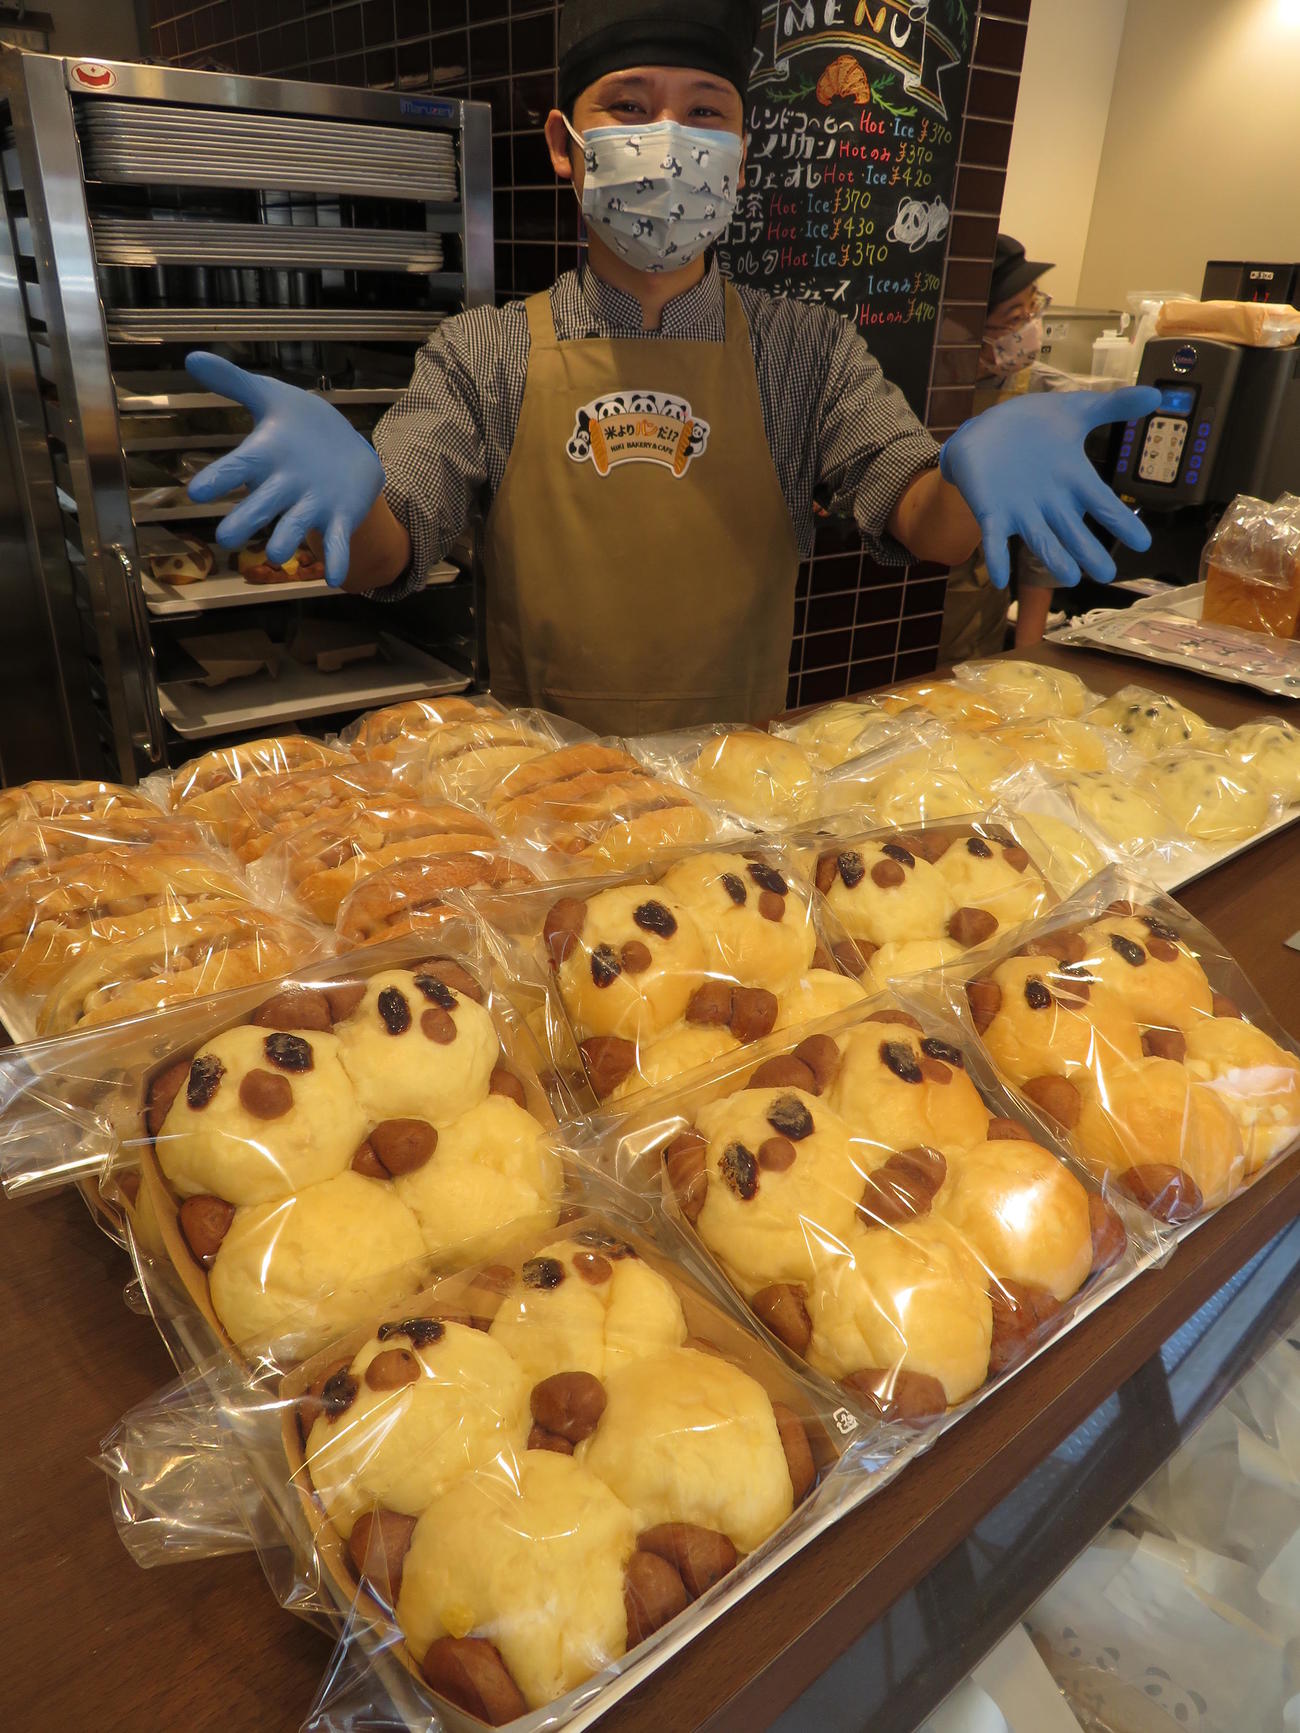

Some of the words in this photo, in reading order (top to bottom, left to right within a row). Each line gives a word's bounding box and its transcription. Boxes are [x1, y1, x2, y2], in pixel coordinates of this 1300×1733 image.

[783, 0, 912, 48] MENU
[746, 106, 855, 134] レンドコーヒー
[860, 108, 885, 135] Hot
[893, 117, 915, 137] Ice
[824, 163, 855, 184] Hot
[866, 164, 887, 185] Ice
[889, 165, 932, 186] ¥420
[769, 192, 797, 217] Hot
[808, 192, 829, 213] Ice
[831, 187, 872, 215] ¥370
[767, 221, 797, 241] Hot
[805, 220, 829, 239] Ice
[829, 216, 875, 241] ¥430
[780, 246, 808, 269] Hot
[814, 245, 837, 268] Ice
[838, 242, 889, 268] ¥370
